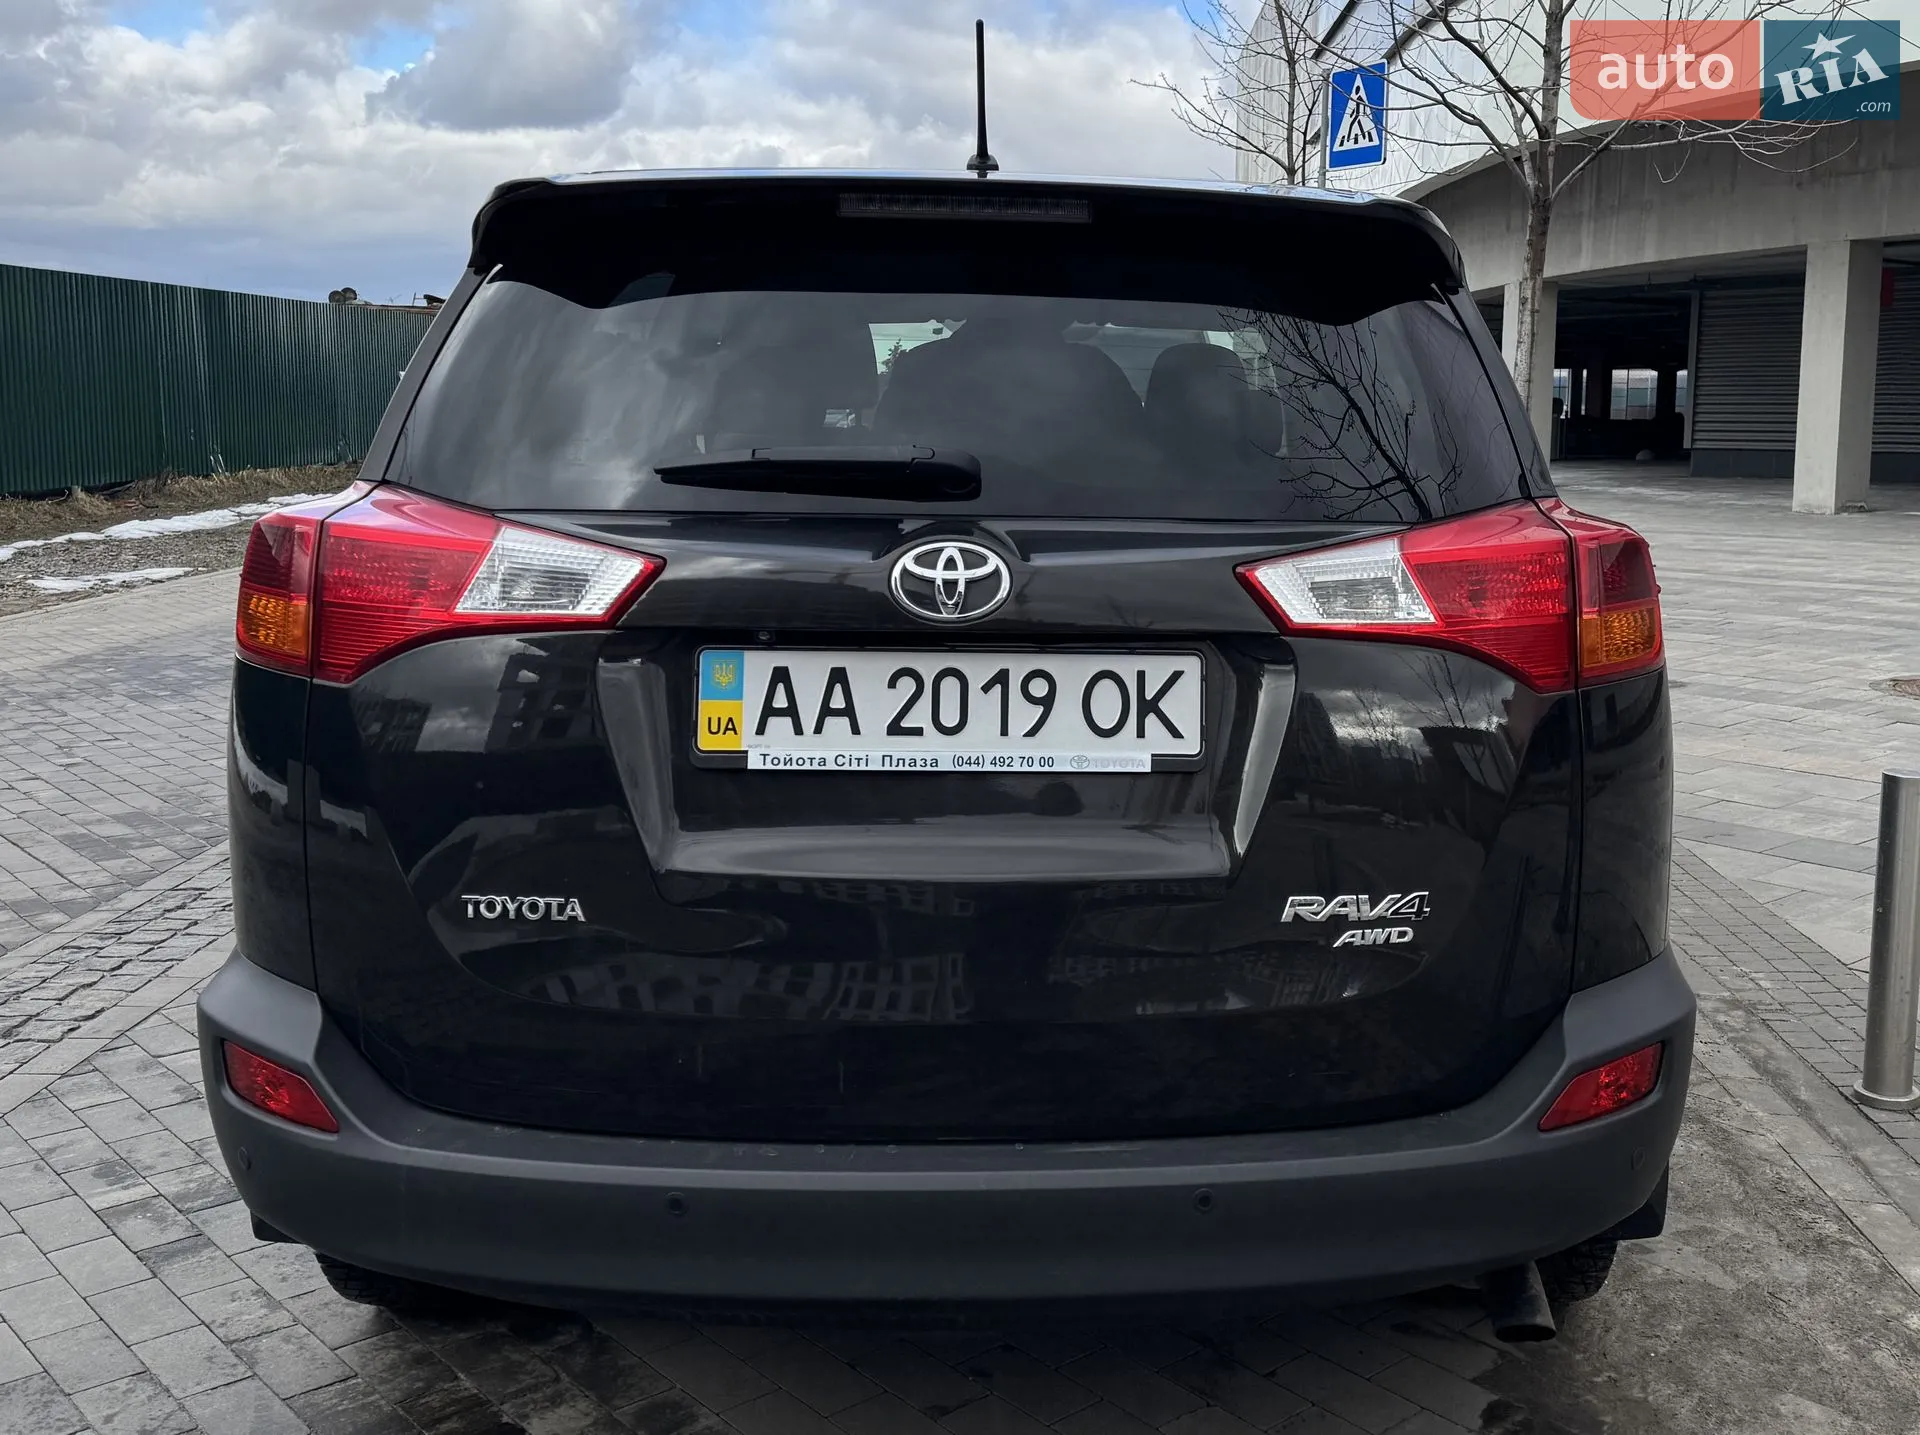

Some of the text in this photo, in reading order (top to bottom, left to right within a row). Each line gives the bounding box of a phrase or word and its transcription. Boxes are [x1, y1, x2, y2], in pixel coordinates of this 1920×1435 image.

[754, 665, 1185, 739] AA 2019 OK
[706, 717, 739, 736] UA
[759, 752, 1055, 769] Тойота Сіті Плаза (044) 492 70 00
[1091, 757, 1147, 769] TOYOTA
[461, 895, 587, 922] TOYOTA
[1280, 891, 1431, 923] RAV4
[1332, 926, 1414, 948] AWD
